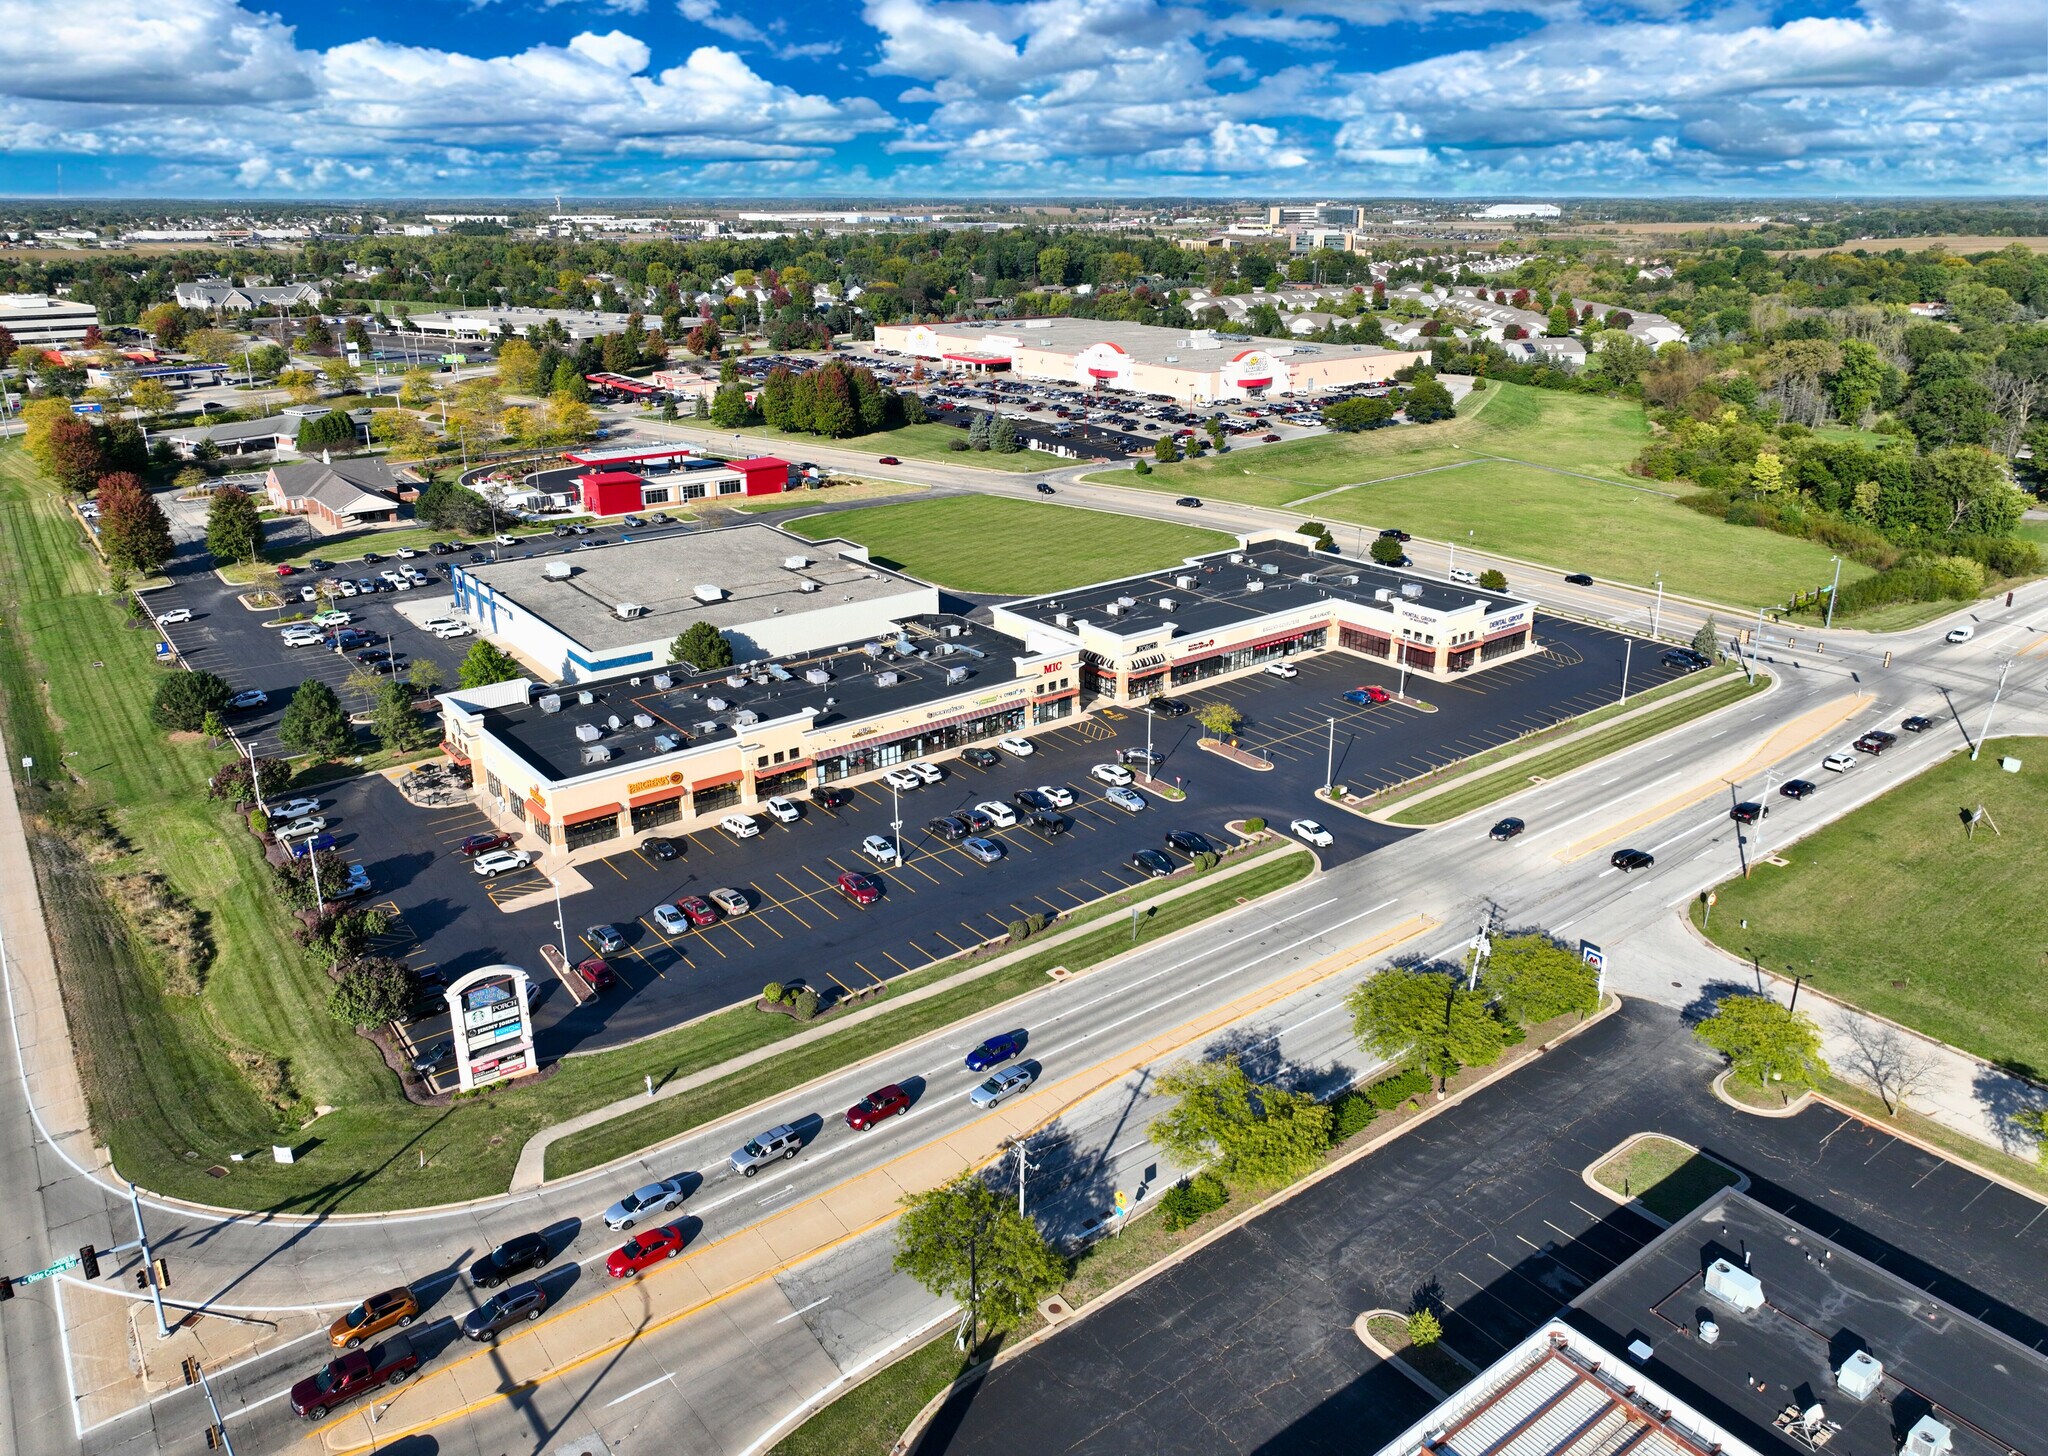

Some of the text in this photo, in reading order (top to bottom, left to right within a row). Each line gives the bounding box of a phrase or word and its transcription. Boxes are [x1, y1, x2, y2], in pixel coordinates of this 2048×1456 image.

[1402, 610, 1437, 623] DENTAL GROUP
[1489, 613, 1524, 628] DENTAL GROUP
[1138, 642, 1158, 652] PORCH
[1044, 661, 1062, 674] MIC
[493, 1000, 517, 1012] PORCH
[477, 1023, 498, 1035] JIMMY
[28, 1260, 75, 1283] Olde Creek Rd
